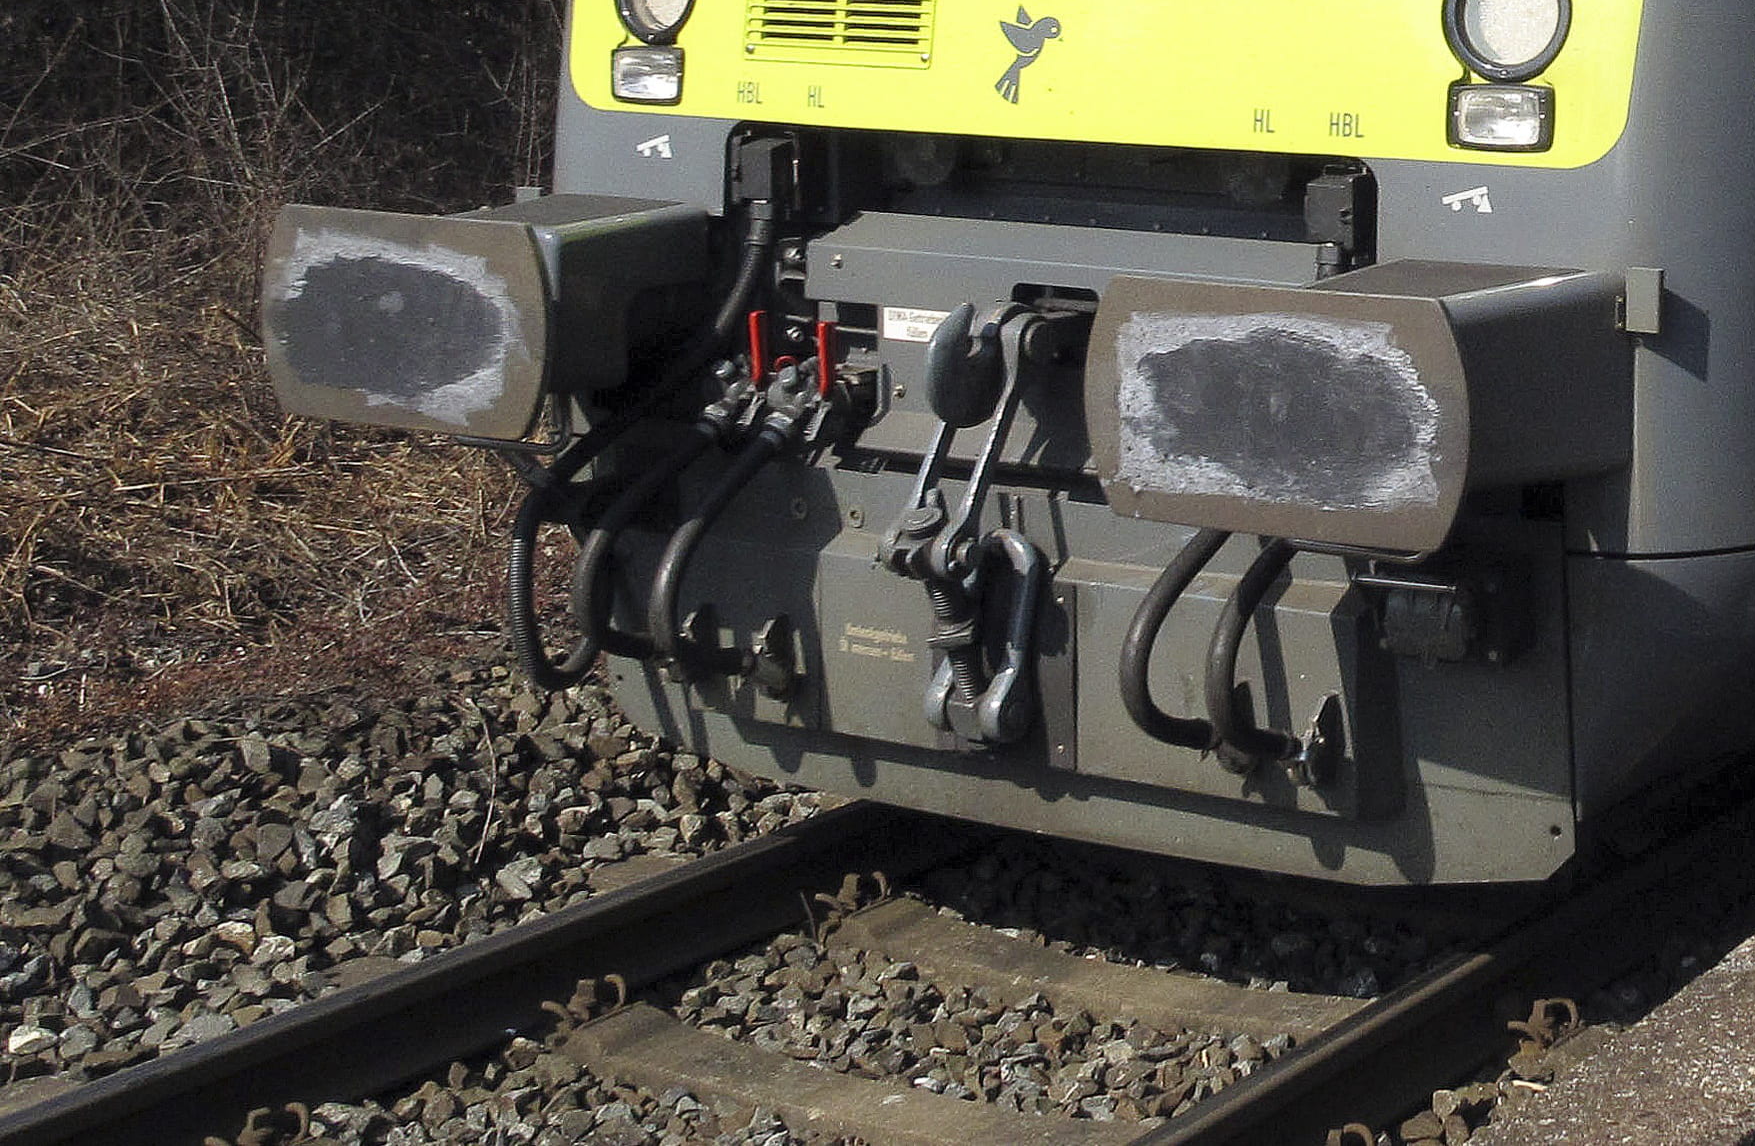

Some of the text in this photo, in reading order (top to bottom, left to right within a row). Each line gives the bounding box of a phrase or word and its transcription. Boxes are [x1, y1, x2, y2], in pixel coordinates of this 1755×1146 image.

[737, 80, 763, 105] HBL
[807, 85, 825, 109] HL
[1253, 107, 1276, 134] HL
[1328, 111, 1365, 138] HBL
